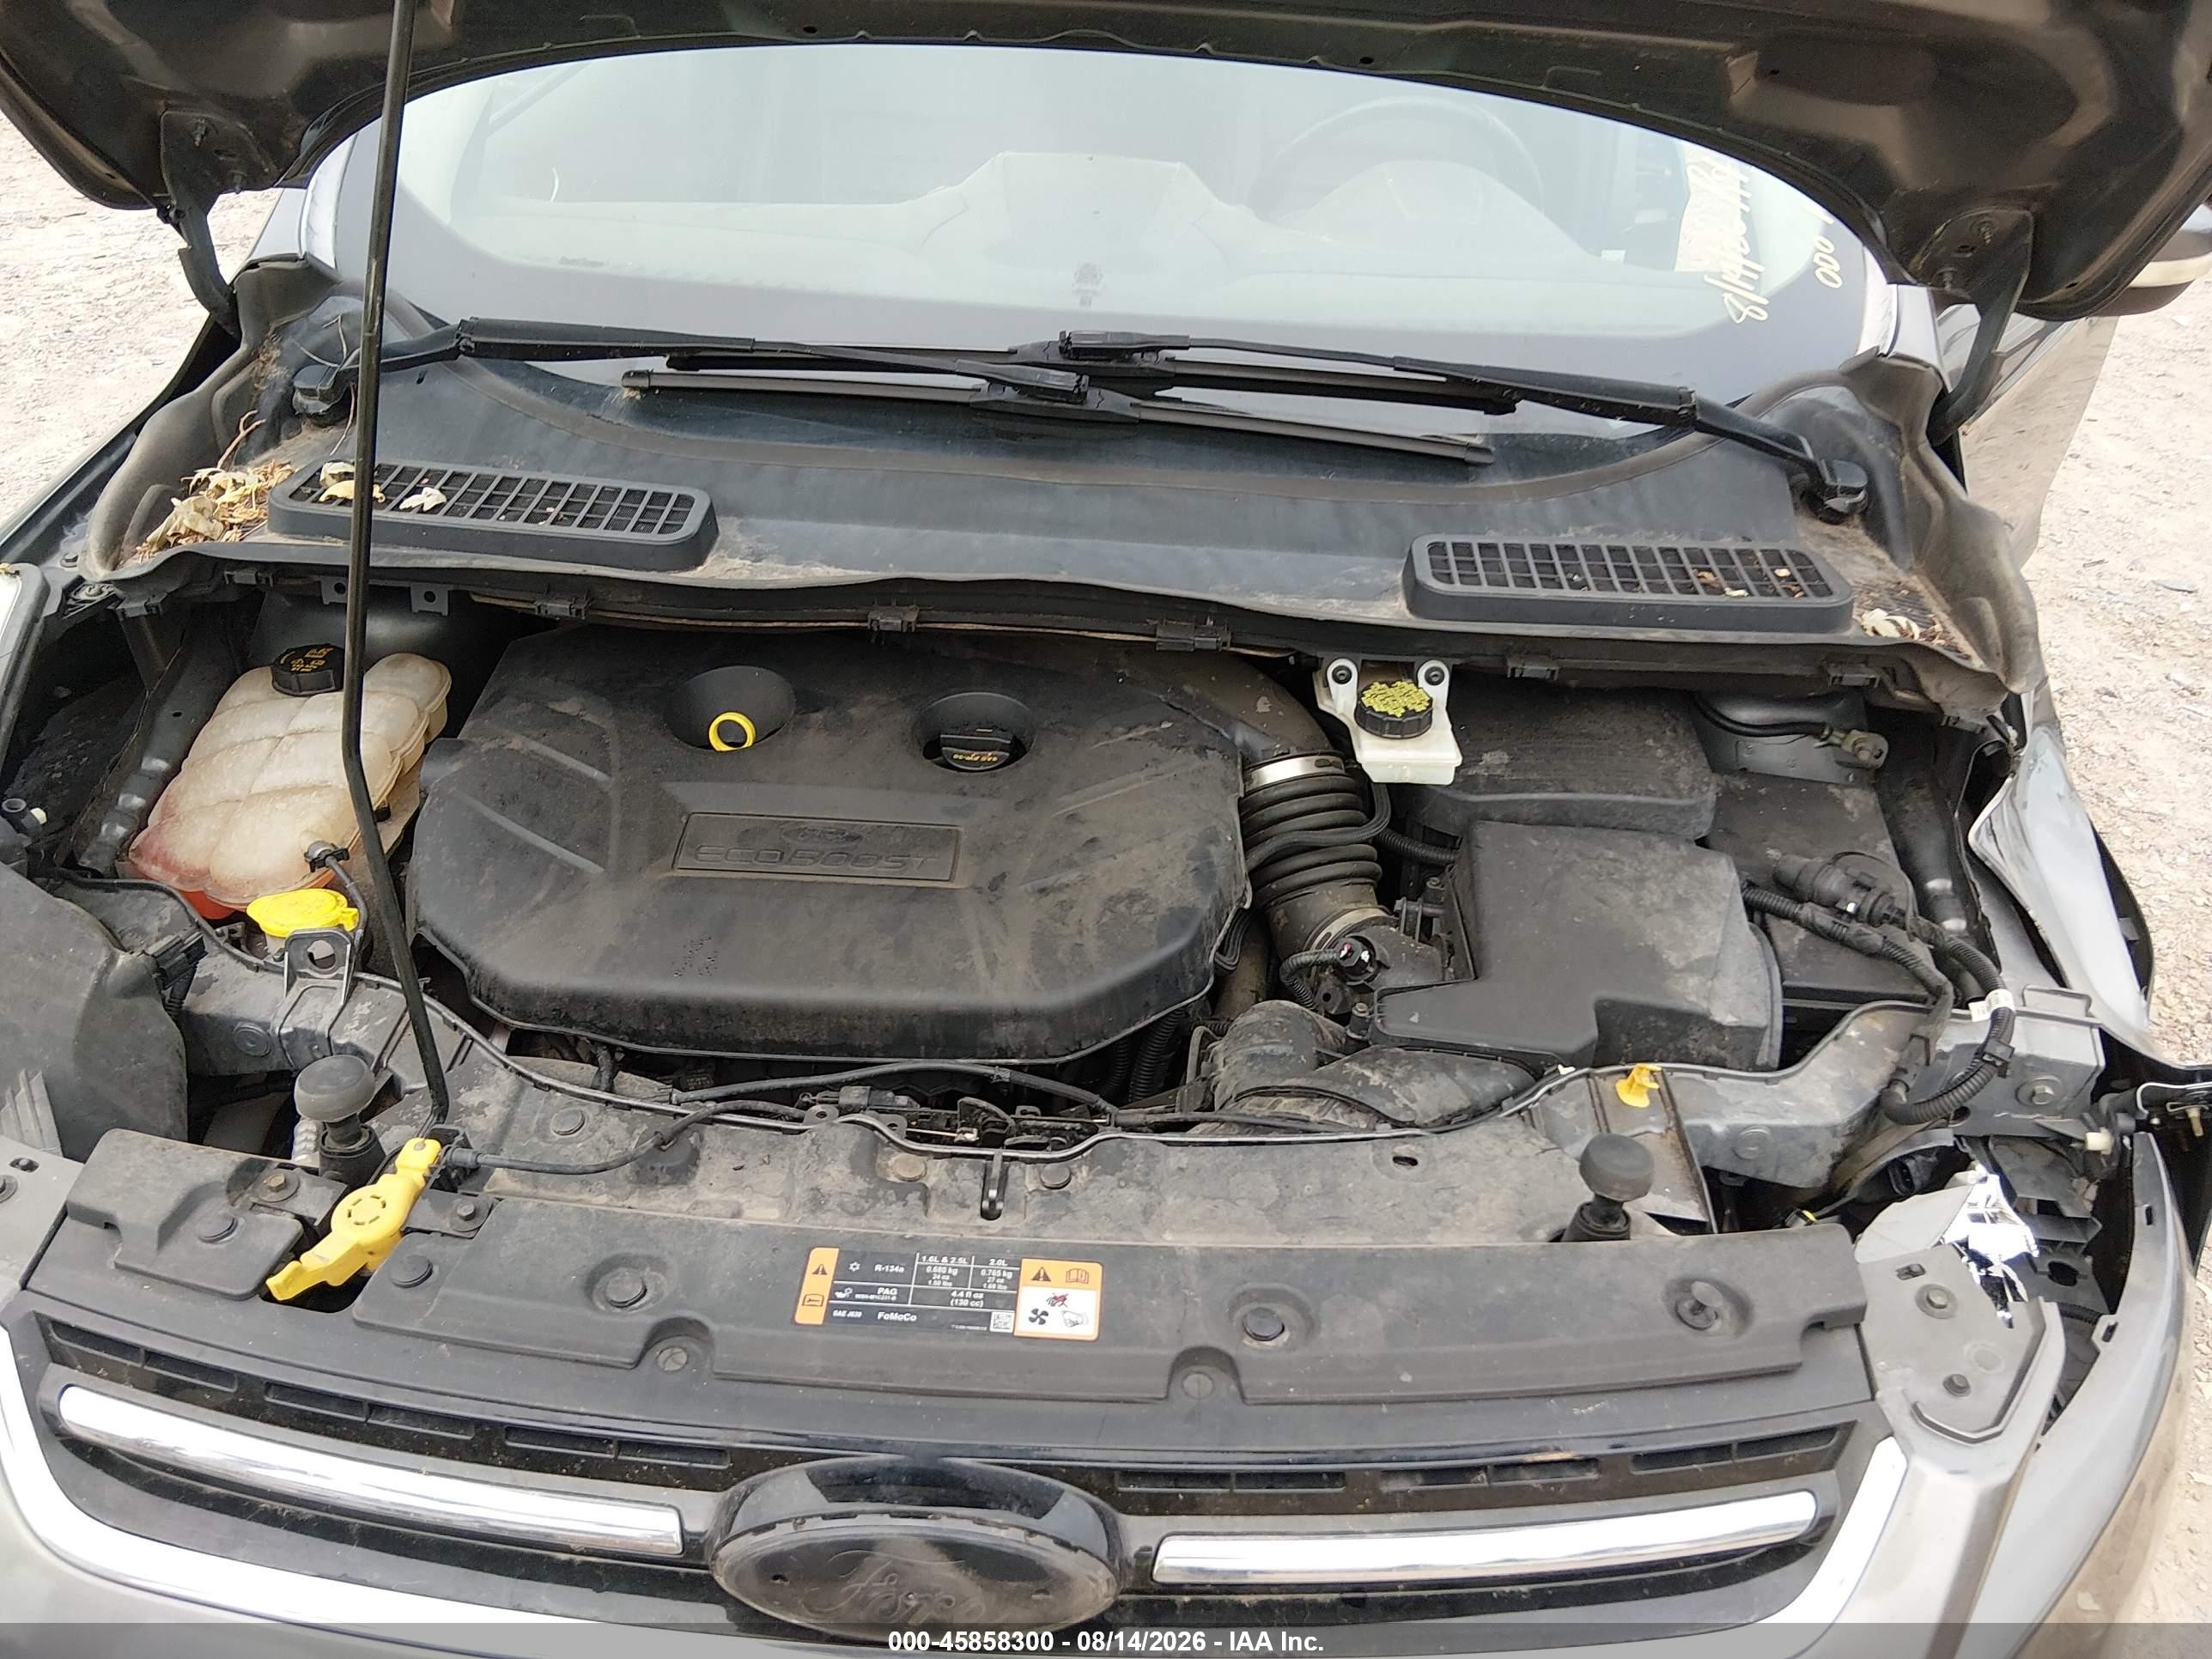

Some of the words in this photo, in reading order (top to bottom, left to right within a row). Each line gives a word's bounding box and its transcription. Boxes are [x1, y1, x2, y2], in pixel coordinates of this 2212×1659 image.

[694, 844, 937, 871] ECOBOOST
[874, 1264, 905, 1273] R-134a
[948, 1267, 958, 1276] kg
[1003, 1270, 1013, 1279] kg
[878, 1311, 917, 1322] FoMoCo
